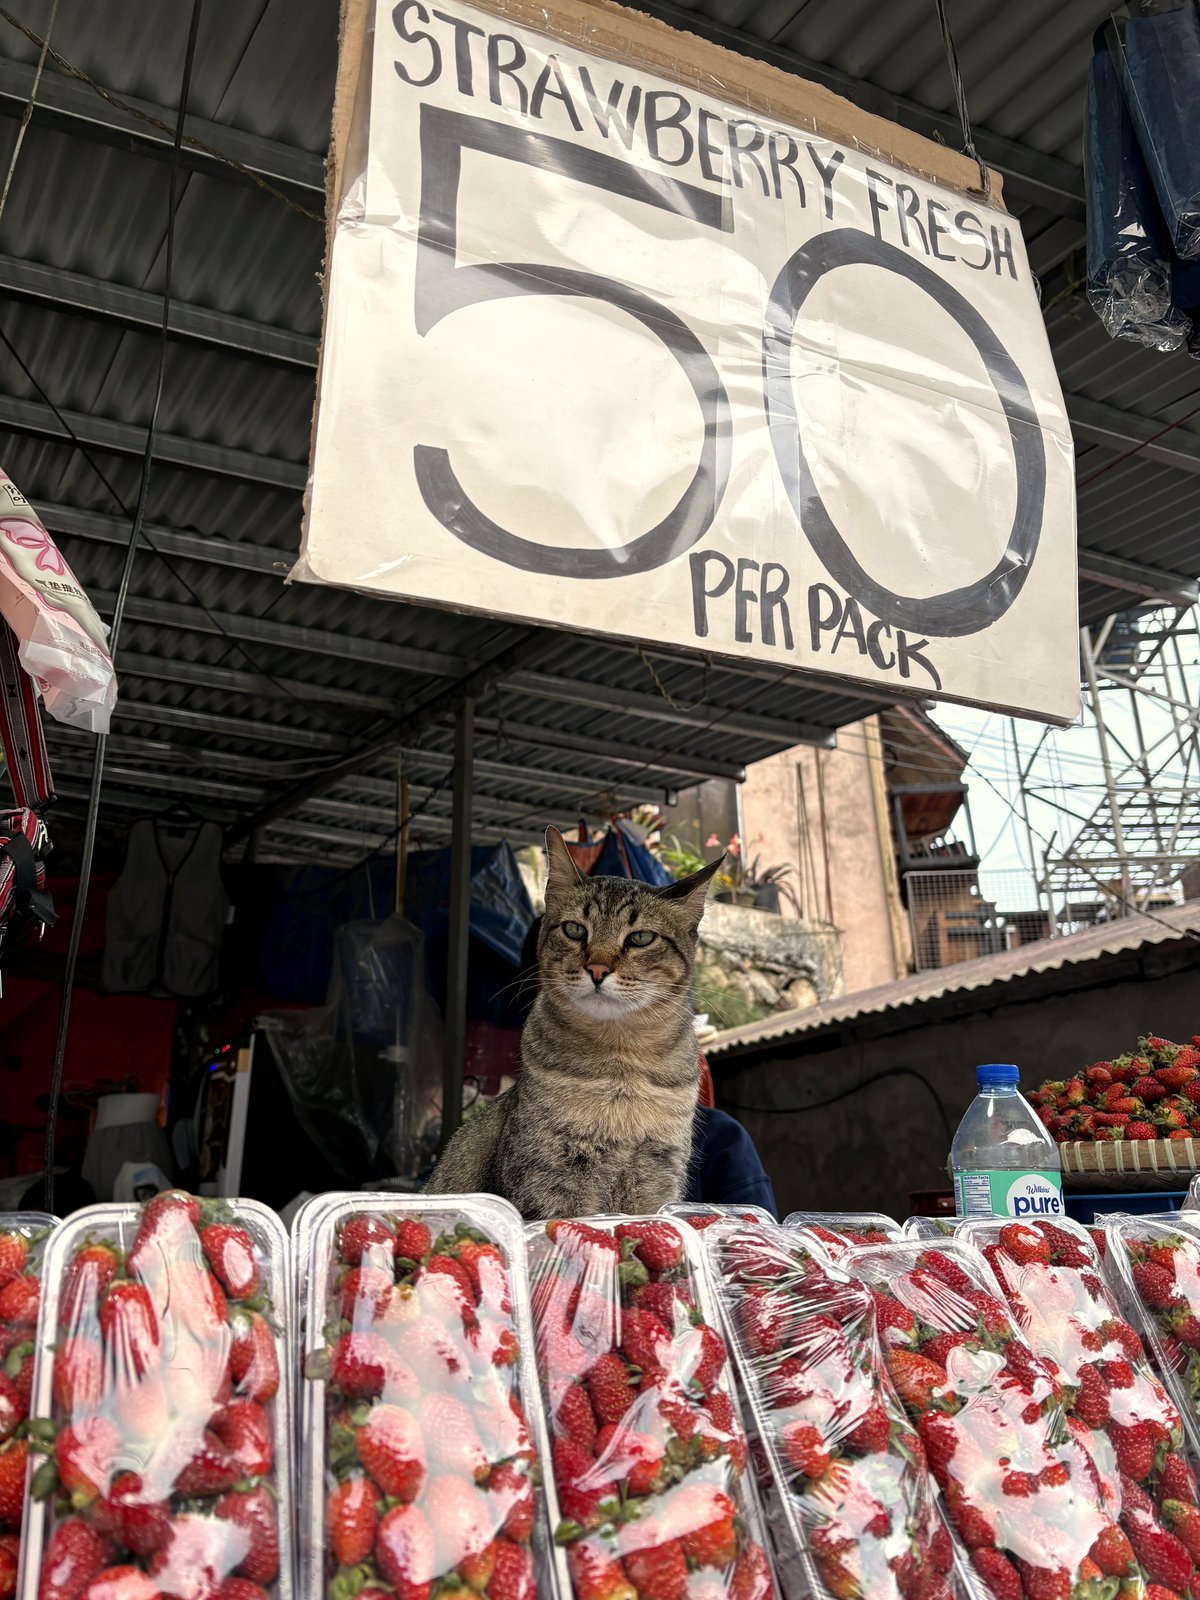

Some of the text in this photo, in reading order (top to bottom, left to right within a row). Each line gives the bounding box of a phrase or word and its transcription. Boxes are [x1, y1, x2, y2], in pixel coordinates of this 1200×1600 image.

[391, 0, 1018, 281] STRAWBERRY FRESH
[414, 102, 1047, 637] 50
[689, 550, 942, 691] PER PACK
[1013, 1196, 1060, 1217] pure
